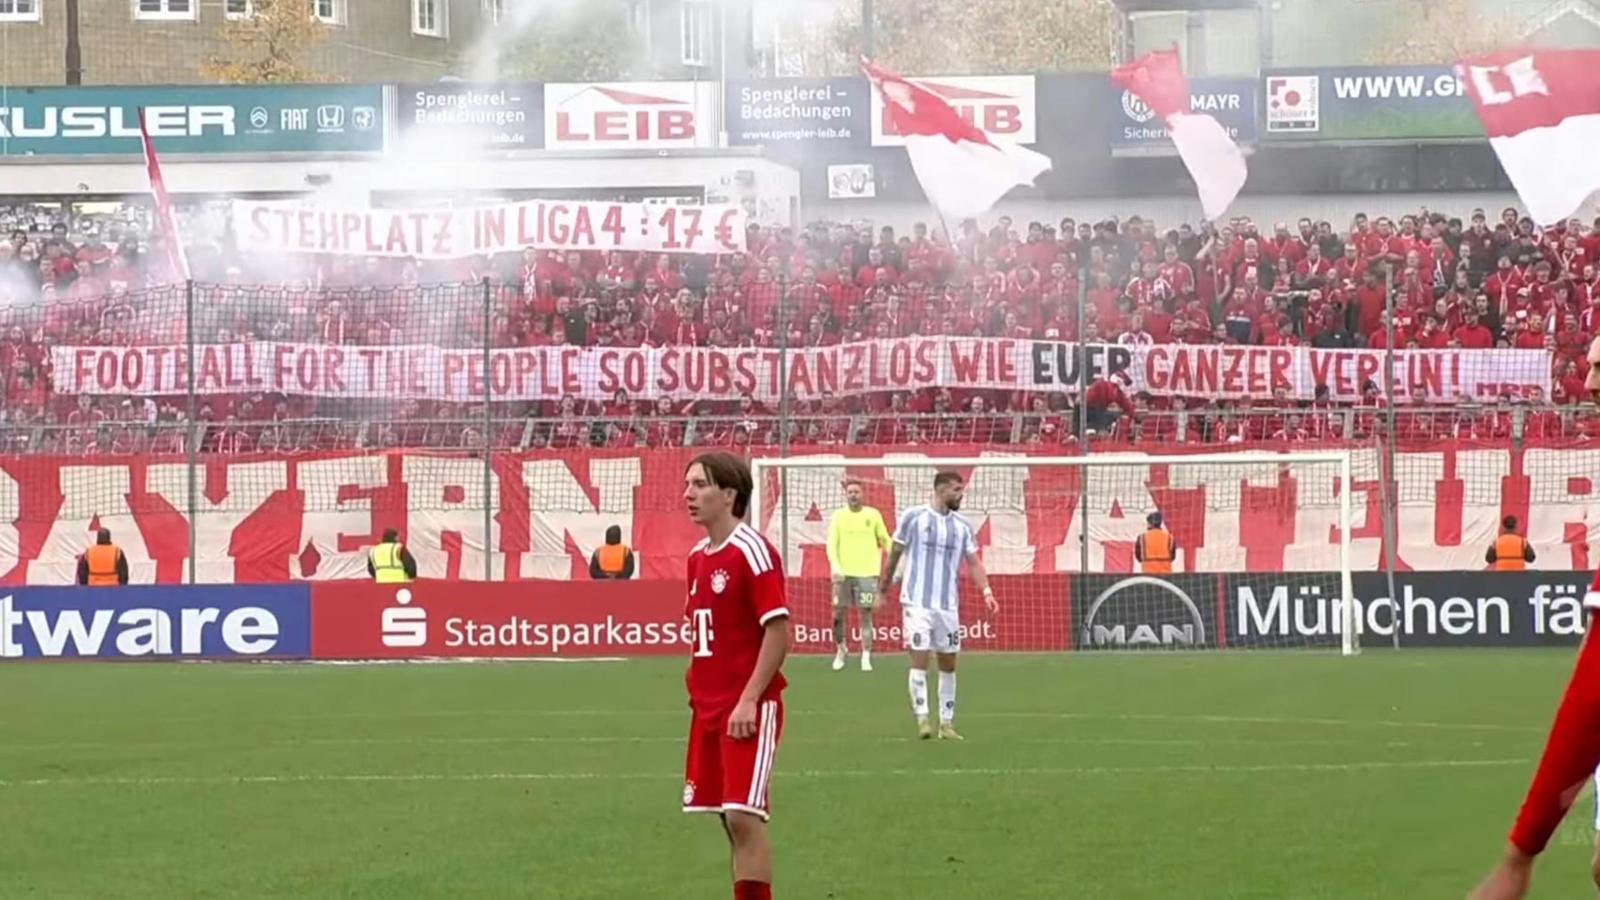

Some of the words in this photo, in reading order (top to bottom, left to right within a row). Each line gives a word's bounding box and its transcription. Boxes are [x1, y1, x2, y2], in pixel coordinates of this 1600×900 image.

[741, 85, 831, 102] Spenglerei
[1190, 94, 1240, 111] MAYR
[280, 108, 309, 131] FIAT
[740, 102, 852, 120] Bedachungen
[556, 110, 696, 141] LEIB
[250, 206, 454, 255] STEHPLATZ
[474, 209, 505, 248] IN
[517, 203, 595, 246] LIGA
[601, 205, 625, 245] 4
[659, 208, 702, 249] 17
[714, 208, 738, 250] €
[275, 345, 345, 390] FOR
[359, 350, 427, 393] THE
[443, 350, 581, 396] PEOPLE
[599, 351, 646, 393] SO
[657, 338, 937, 396] SUBSTANZLOS
[950, 340, 1018, 384] WIE
[1145, 346, 1293, 398] GANZER
[1309, 351, 1461, 396] VEREIN!
[859, 592, 873, 604] 30
[1237, 585, 1510, 635] München
[445, 615, 691, 652] Stadtsparkasse
[1094, 624, 1194, 644] MAN
